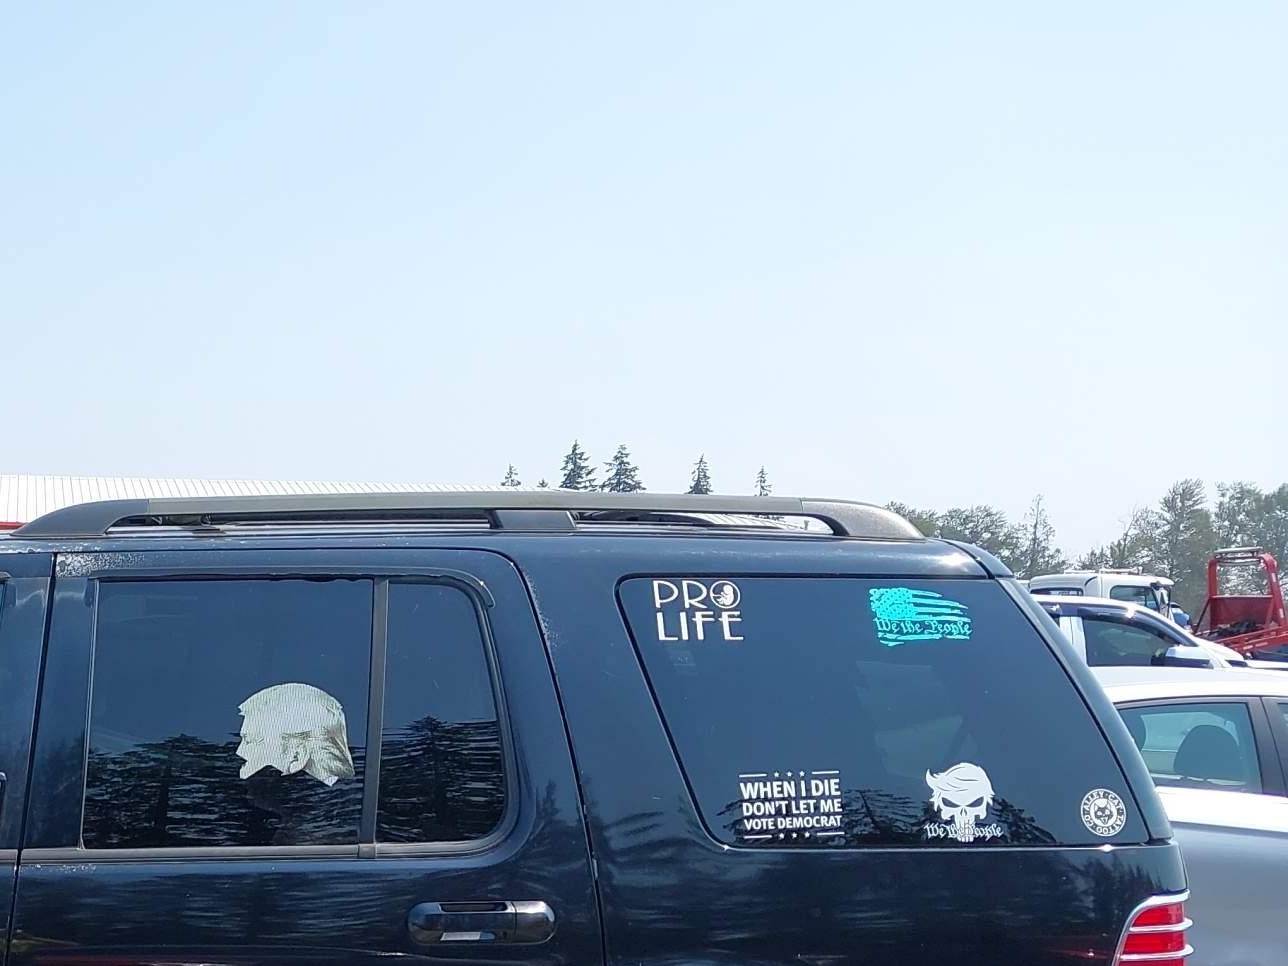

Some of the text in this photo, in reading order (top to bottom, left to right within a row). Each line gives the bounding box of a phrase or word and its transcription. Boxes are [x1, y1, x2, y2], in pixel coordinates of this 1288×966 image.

[653, 580, 741, 609] PRO
[656, 611, 744, 640] LIFE
[873, 618, 900, 633] We
[924, 620, 973, 635] People
[739, 778, 841, 800] WHEN I DIE
[742, 798, 843, 817] DON'T LET ME
[744, 815, 843, 831] VOTE DEMOCRAT
[924, 822, 946, 839] We
